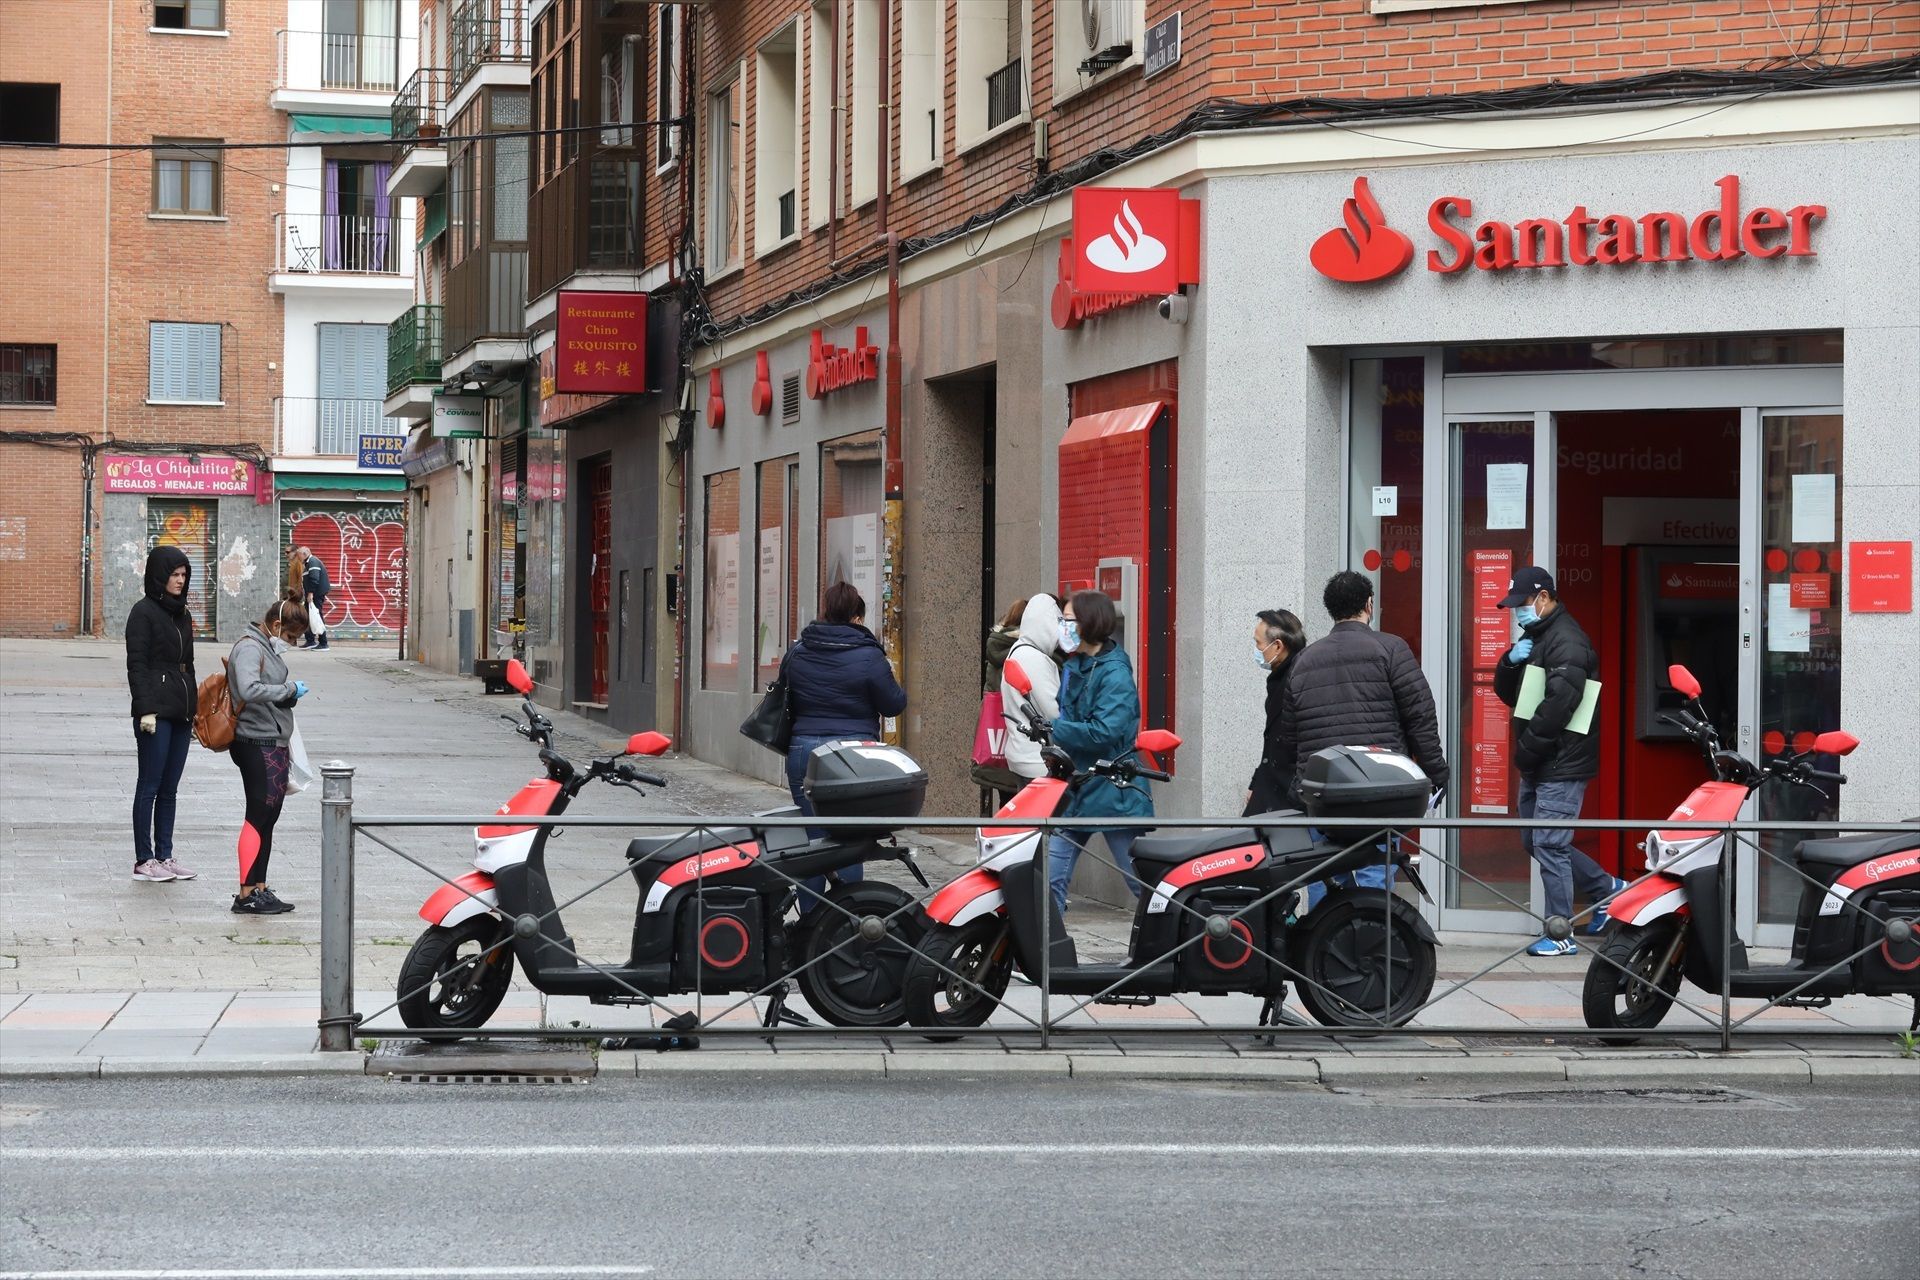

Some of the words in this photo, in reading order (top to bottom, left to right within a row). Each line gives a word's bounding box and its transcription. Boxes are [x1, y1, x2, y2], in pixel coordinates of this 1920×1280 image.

[1428, 174, 1827, 274] Santander
[567, 307, 635, 319] Restaurante
[585, 324, 618, 335] Chino
[568, 341, 637, 352] EXQUISITO
[362, 437, 403, 451] HIPER
[1557, 445, 1682, 475] Seguridad
[132, 459, 153, 478] La
[156, 460, 229, 477] Chiquitita
[110, 479, 156, 489] REGALOS
[164, 480, 205, 490] MENAJE
[212, 481, 247, 491] HOGAR
[1663, 520, 1737, 540] Efectivo
[1476, 552, 1509, 560] Bienvenido
[1685, 575, 1739, 588] Santande
[695, 855, 730, 871] acciona
[1201, 857, 1236, 872] acciona
[1876, 857, 1916, 874] acciona
